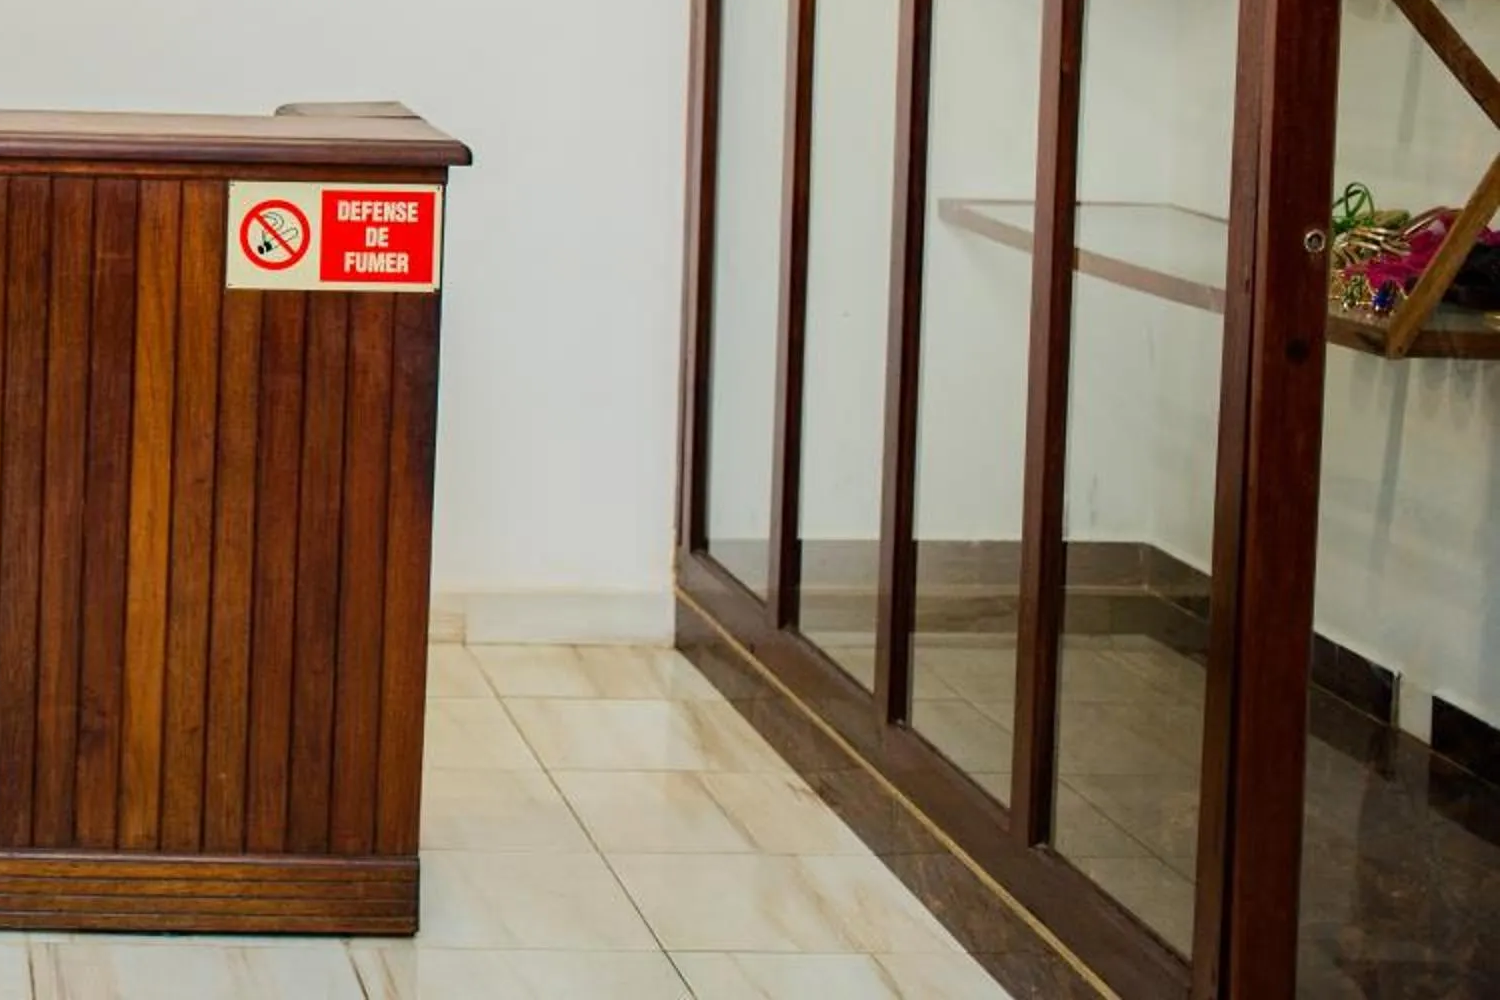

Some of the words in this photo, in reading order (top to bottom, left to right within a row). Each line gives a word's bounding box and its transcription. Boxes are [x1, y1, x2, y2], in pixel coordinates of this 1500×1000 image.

[337, 200, 419, 223] DEFENSE
[365, 226, 389, 248] DE
[343, 251, 409, 275] FUMER
